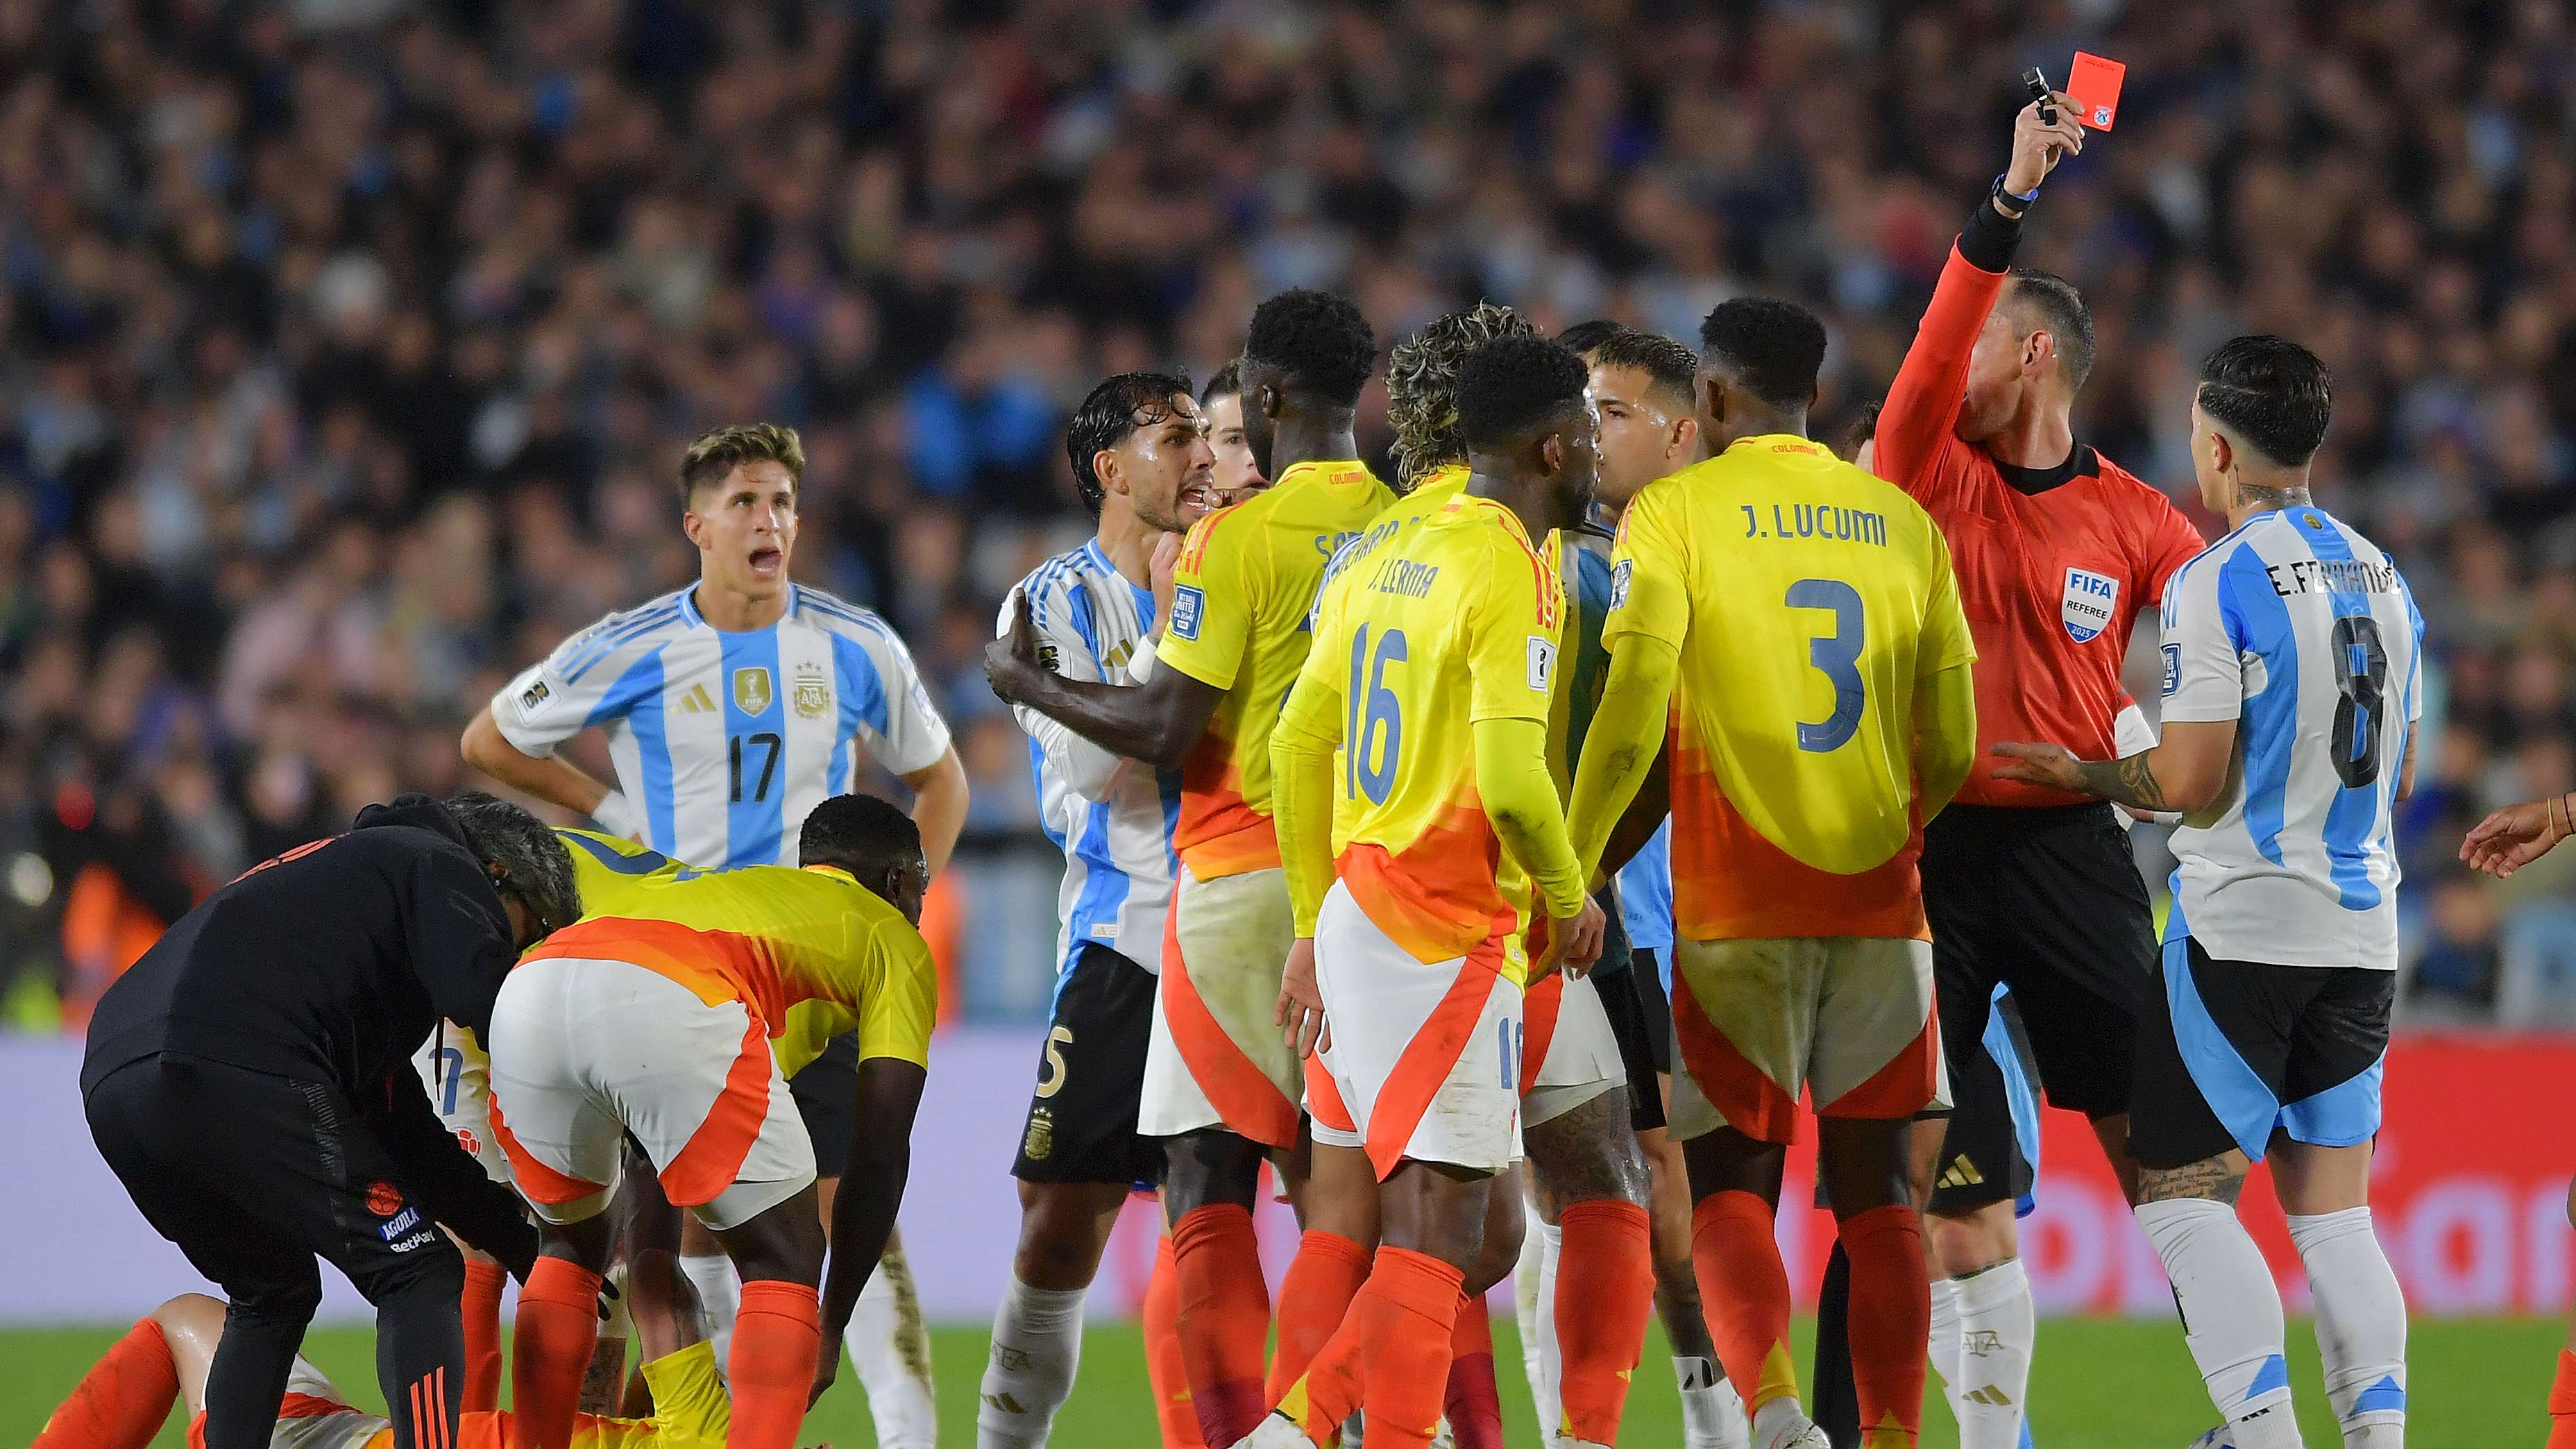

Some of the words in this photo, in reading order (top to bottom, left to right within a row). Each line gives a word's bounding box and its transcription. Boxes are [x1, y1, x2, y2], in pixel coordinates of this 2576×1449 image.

[2066, 600, 2108, 620] REFEREE
[2070, 573, 2111, 600] FIFA
[2071, 625, 2091, 638] 2025
[1784, 578, 1865, 754] 3
[801, 686, 822, 708] AFA
[1347, 621, 1408, 807] 16
[2330, 616, 2387, 789] 8
[729, 733, 781, 804] 17
[428, 1047, 463, 1116] 7
[1035, 1026, 1074, 1099] 5
[382, 1207, 421, 1241] AGUILA
[390, 1230, 436, 1253] BetPlay
